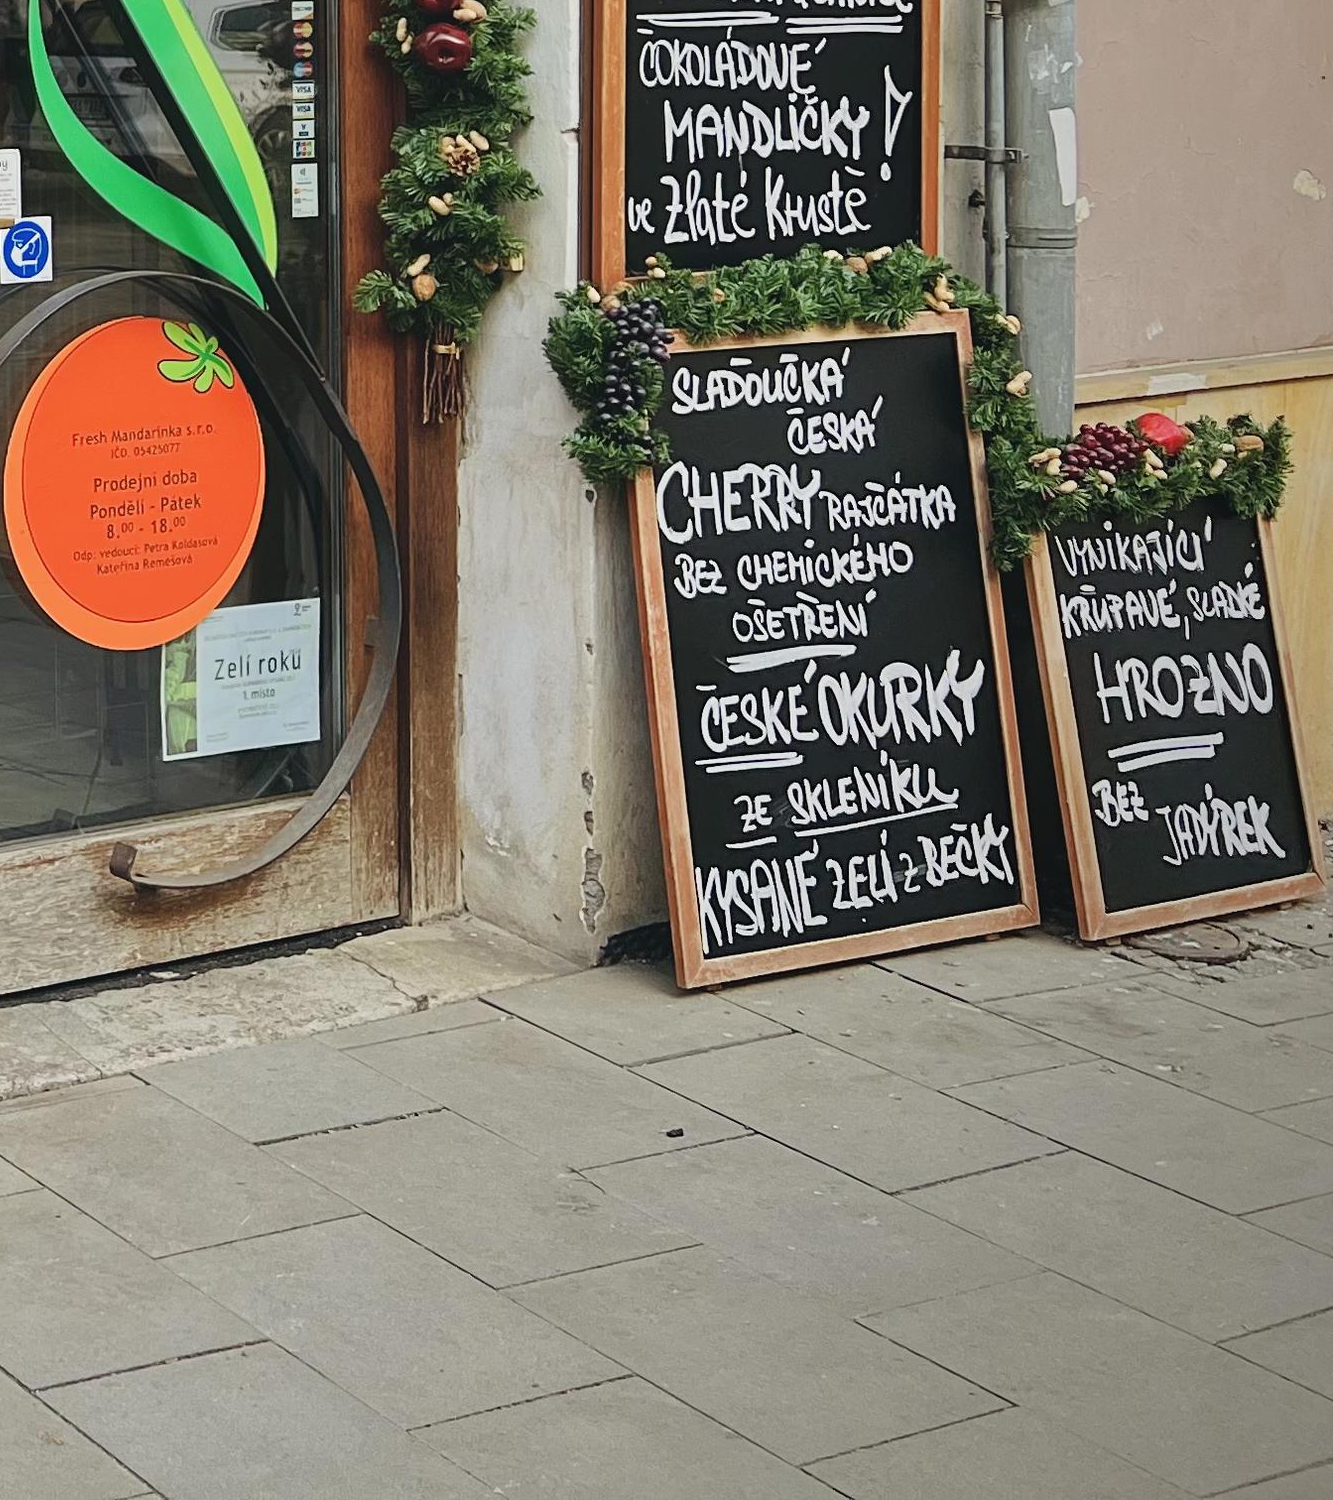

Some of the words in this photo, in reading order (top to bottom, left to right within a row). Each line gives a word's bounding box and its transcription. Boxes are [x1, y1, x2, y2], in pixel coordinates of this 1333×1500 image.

[628, 196, 654, 233] ve
[72, 431, 107, 447] Fresh
[111, 424, 182, 443] Mandarinka
[786, 396, 883, 455] ČESKÁ
[93, 472, 157, 493] Prodejní
[162, 469, 198, 487] doba
[90, 500, 145, 520] Pondělí
[161, 493, 203, 512] Pátek
[656, 461, 821, 544] CHERRY
[144, 542, 169, 555] Petra
[674, 553, 727, 599] BEZ
[214, 653, 251, 681] Zelí
[1094, 643, 1272, 724] HROZNO
[818, 649, 985, 750] OKURKY
[734, 795, 772, 833] ZE
[1091, 779, 1149, 828] BEZ
